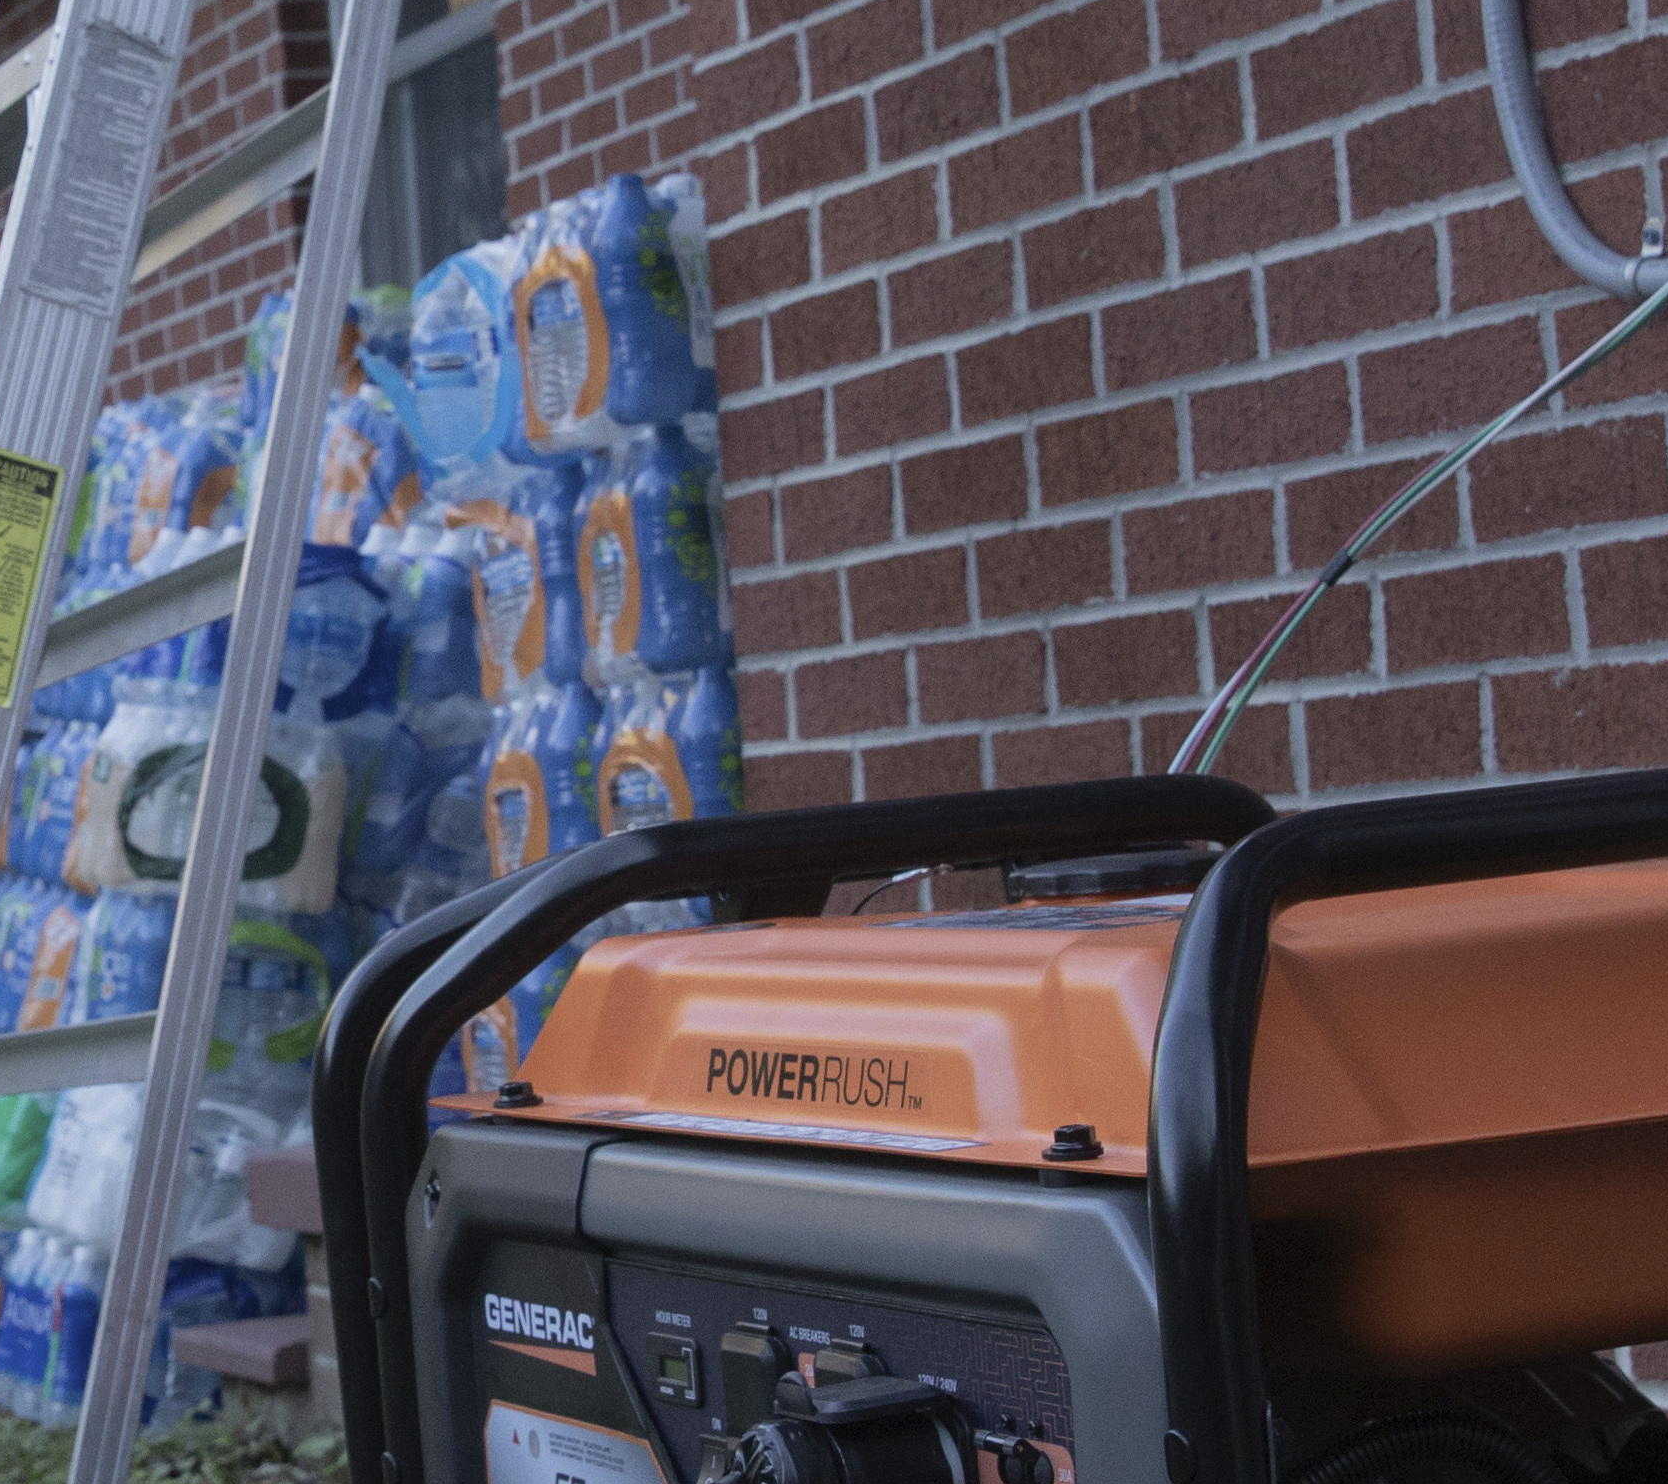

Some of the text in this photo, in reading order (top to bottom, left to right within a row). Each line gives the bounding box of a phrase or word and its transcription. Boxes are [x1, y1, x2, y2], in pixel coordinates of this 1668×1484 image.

[706, 1048, 909, 1108] POWERRUSH
[484, 1293, 594, 1350] GENERAC
[789, 1325, 798, 1339] AC
